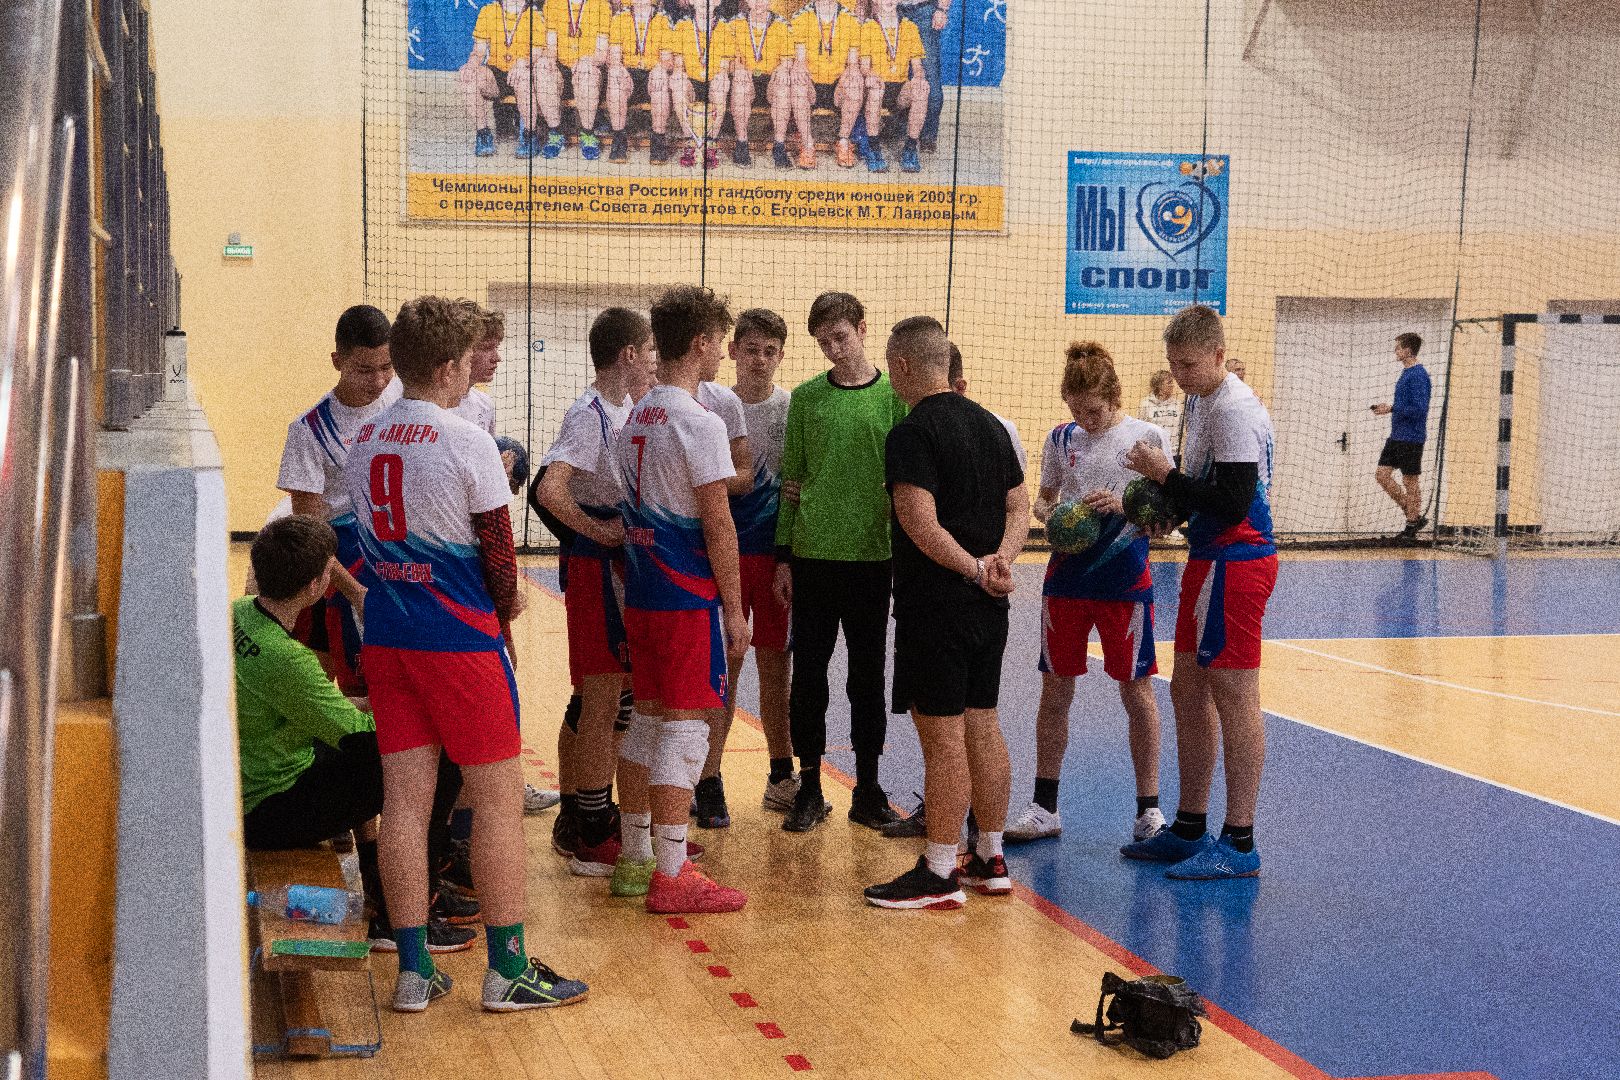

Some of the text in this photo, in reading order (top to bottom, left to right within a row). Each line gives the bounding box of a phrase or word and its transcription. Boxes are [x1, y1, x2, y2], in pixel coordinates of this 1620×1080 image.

[432, 178, 982, 206] Чемпионы первенства России по гандболу среди юношей 2003 г.р.
[439, 199, 976, 221] с председателем Совета депутатов г.о. Егорьевск М.Т. Лавровым
[1075, 186, 1126, 251] МЫ
[1081, 267, 1215, 292] спорт
[631, 436, 646, 510] 7
[370, 454, 407, 542] 9
